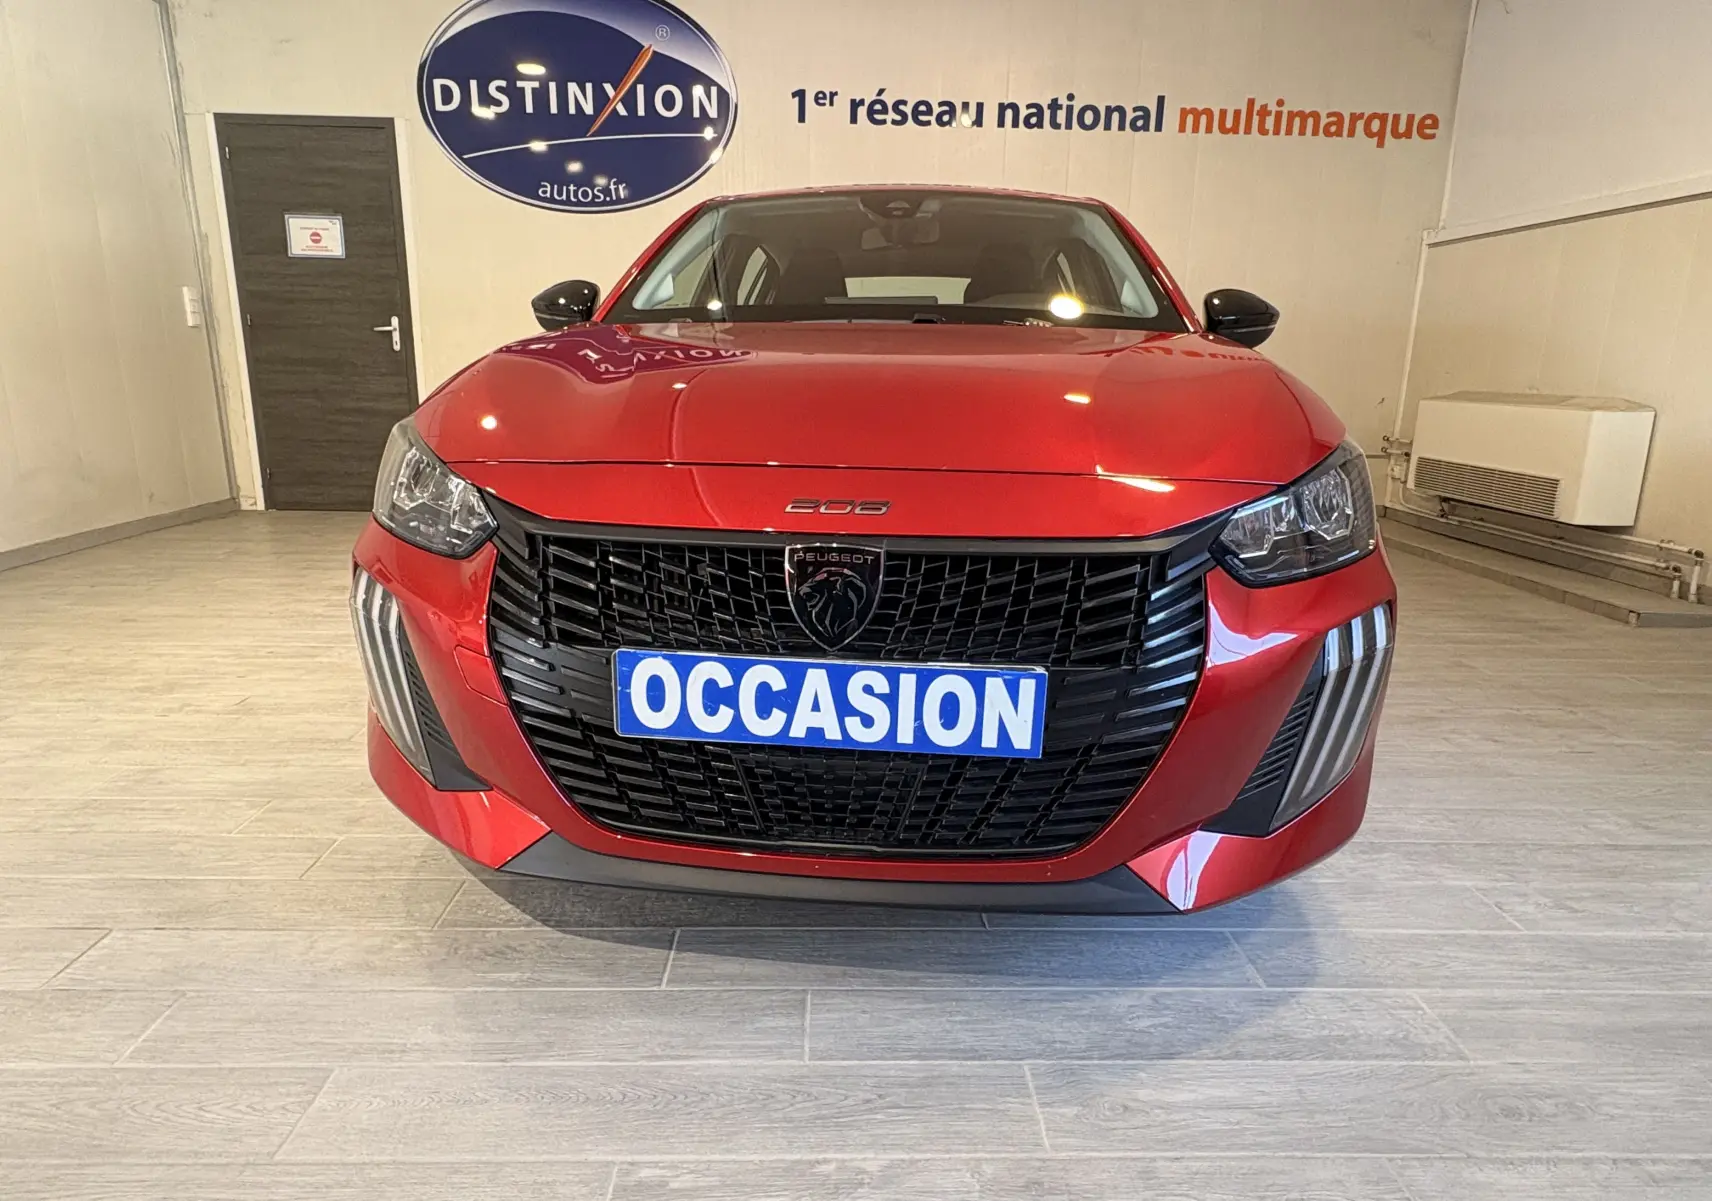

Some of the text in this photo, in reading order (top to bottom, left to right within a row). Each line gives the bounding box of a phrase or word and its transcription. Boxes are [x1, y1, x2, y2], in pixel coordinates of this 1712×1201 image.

[432, 78, 718, 118] DISTINXION
[791, 88, 1440, 149] 1er réseau national multimarque
[538, 178, 627, 202] autos.fr
[784, 498, 892, 515] 208
[794, 551, 875, 565] PEUGEOT
[630, 657, 1036, 750] OCCASION
